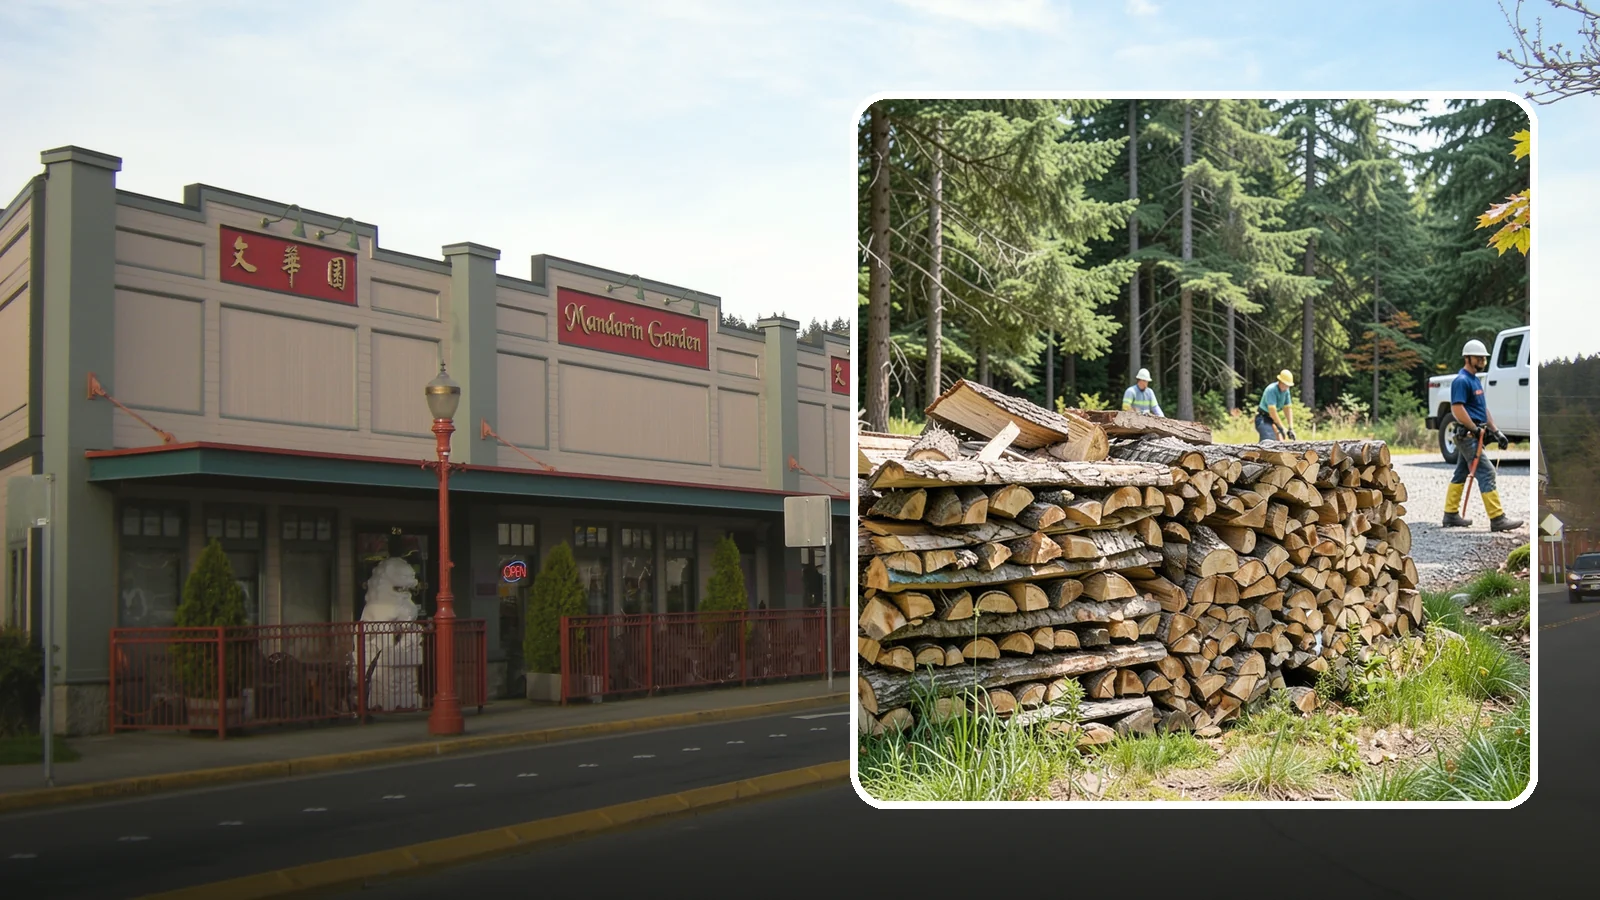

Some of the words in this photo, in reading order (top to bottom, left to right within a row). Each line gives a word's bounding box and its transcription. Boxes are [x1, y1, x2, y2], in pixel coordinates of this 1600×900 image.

[231, 235, 347, 291] 文華園
[564, 302, 644, 341] Mandarin
[648, 320, 701, 352] Garden
[503, 565, 527, 578] OPEN
